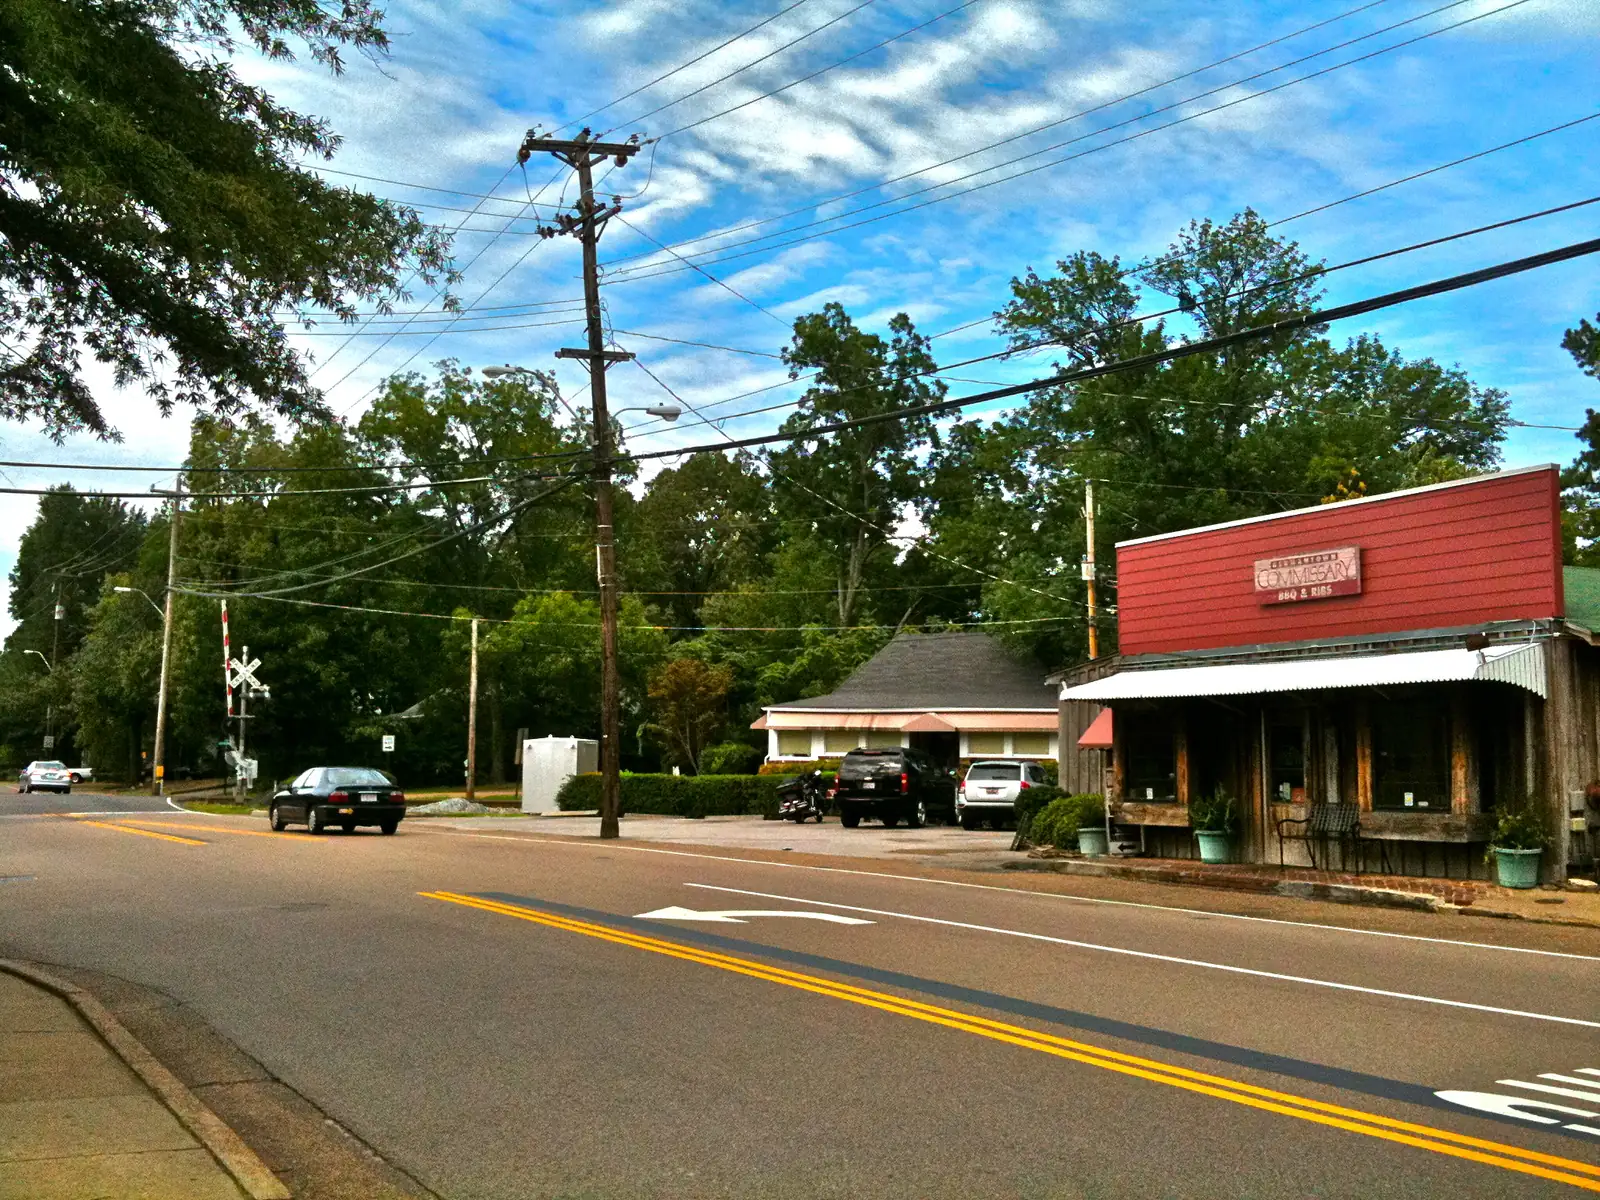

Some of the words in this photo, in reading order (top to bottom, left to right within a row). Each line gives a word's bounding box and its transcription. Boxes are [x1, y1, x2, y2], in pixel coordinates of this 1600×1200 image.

[1258, 559, 1353, 588] COMMISSARY
[1278, 590, 1297, 601] BBQ
[1300, 588, 1308, 598] &
[1311, 585, 1332, 597] RIBS
